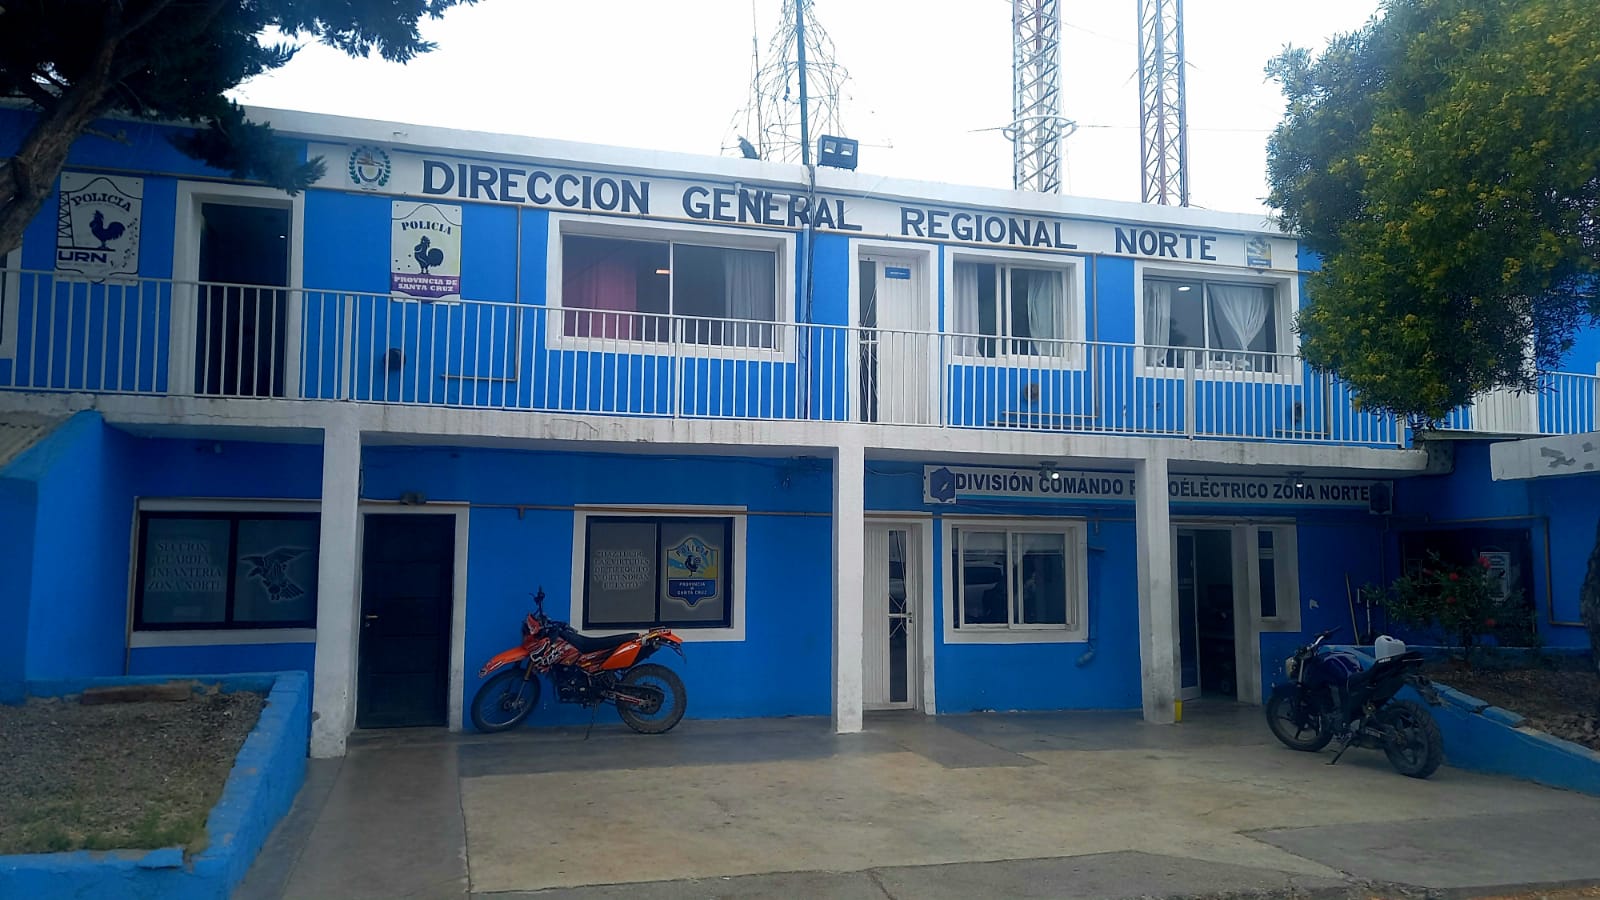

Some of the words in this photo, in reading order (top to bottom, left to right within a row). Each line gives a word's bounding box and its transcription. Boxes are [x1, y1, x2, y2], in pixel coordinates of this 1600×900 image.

[71, 193, 131, 212] POLICIA
[422, 160, 650, 214] DIRECCION
[682, 186, 863, 231] GENERAL
[900, 207, 1077, 249] REGIONAL
[1115, 227, 1217, 261] NORTE
[401, 220, 451, 235] POLICIA
[58, 251, 107, 263] URN
[394, 276, 444, 285] PROVINCIA
[446, 278, 458, 286] DE
[956, 472, 1033, 493] DIVISIÓN
[1273, 483, 1314, 500] ZONA
[1319, 485, 1369, 501] NORTE
